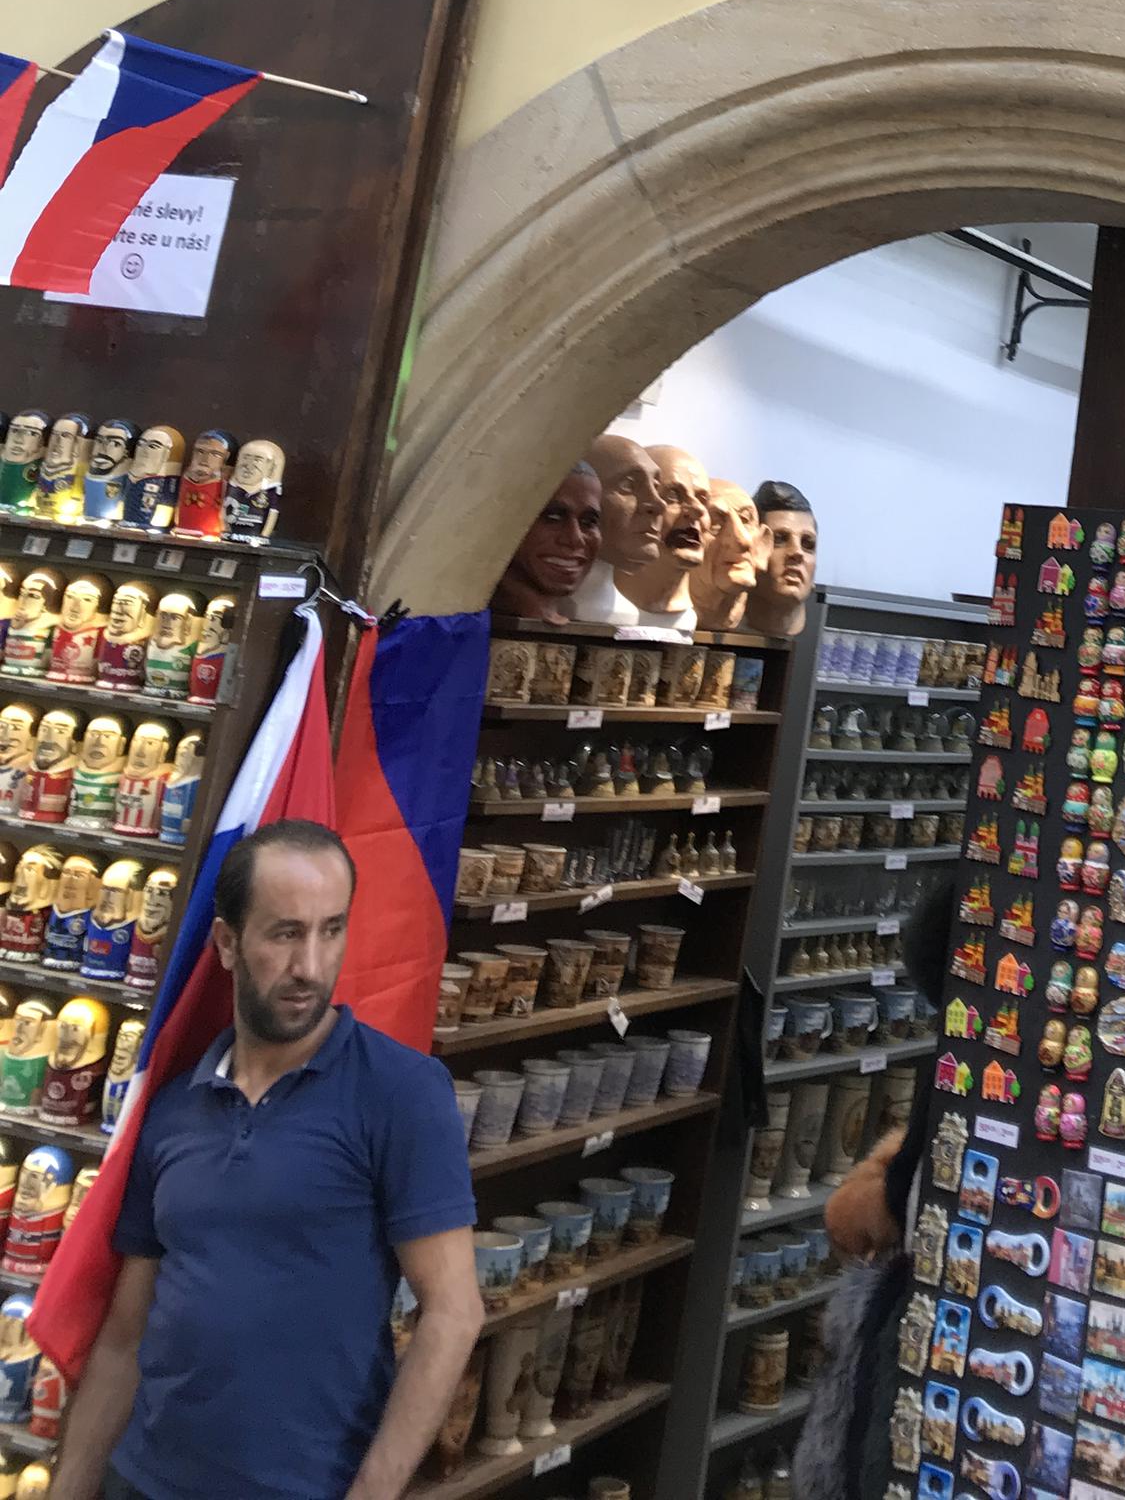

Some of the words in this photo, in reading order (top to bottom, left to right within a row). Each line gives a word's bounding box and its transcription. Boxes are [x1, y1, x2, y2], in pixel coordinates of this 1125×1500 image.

[155, 202, 204, 225] slevy!
[139, 231, 158, 246] se
[161, 234, 173, 248] u
[174, 232, 211, 251] nás!
